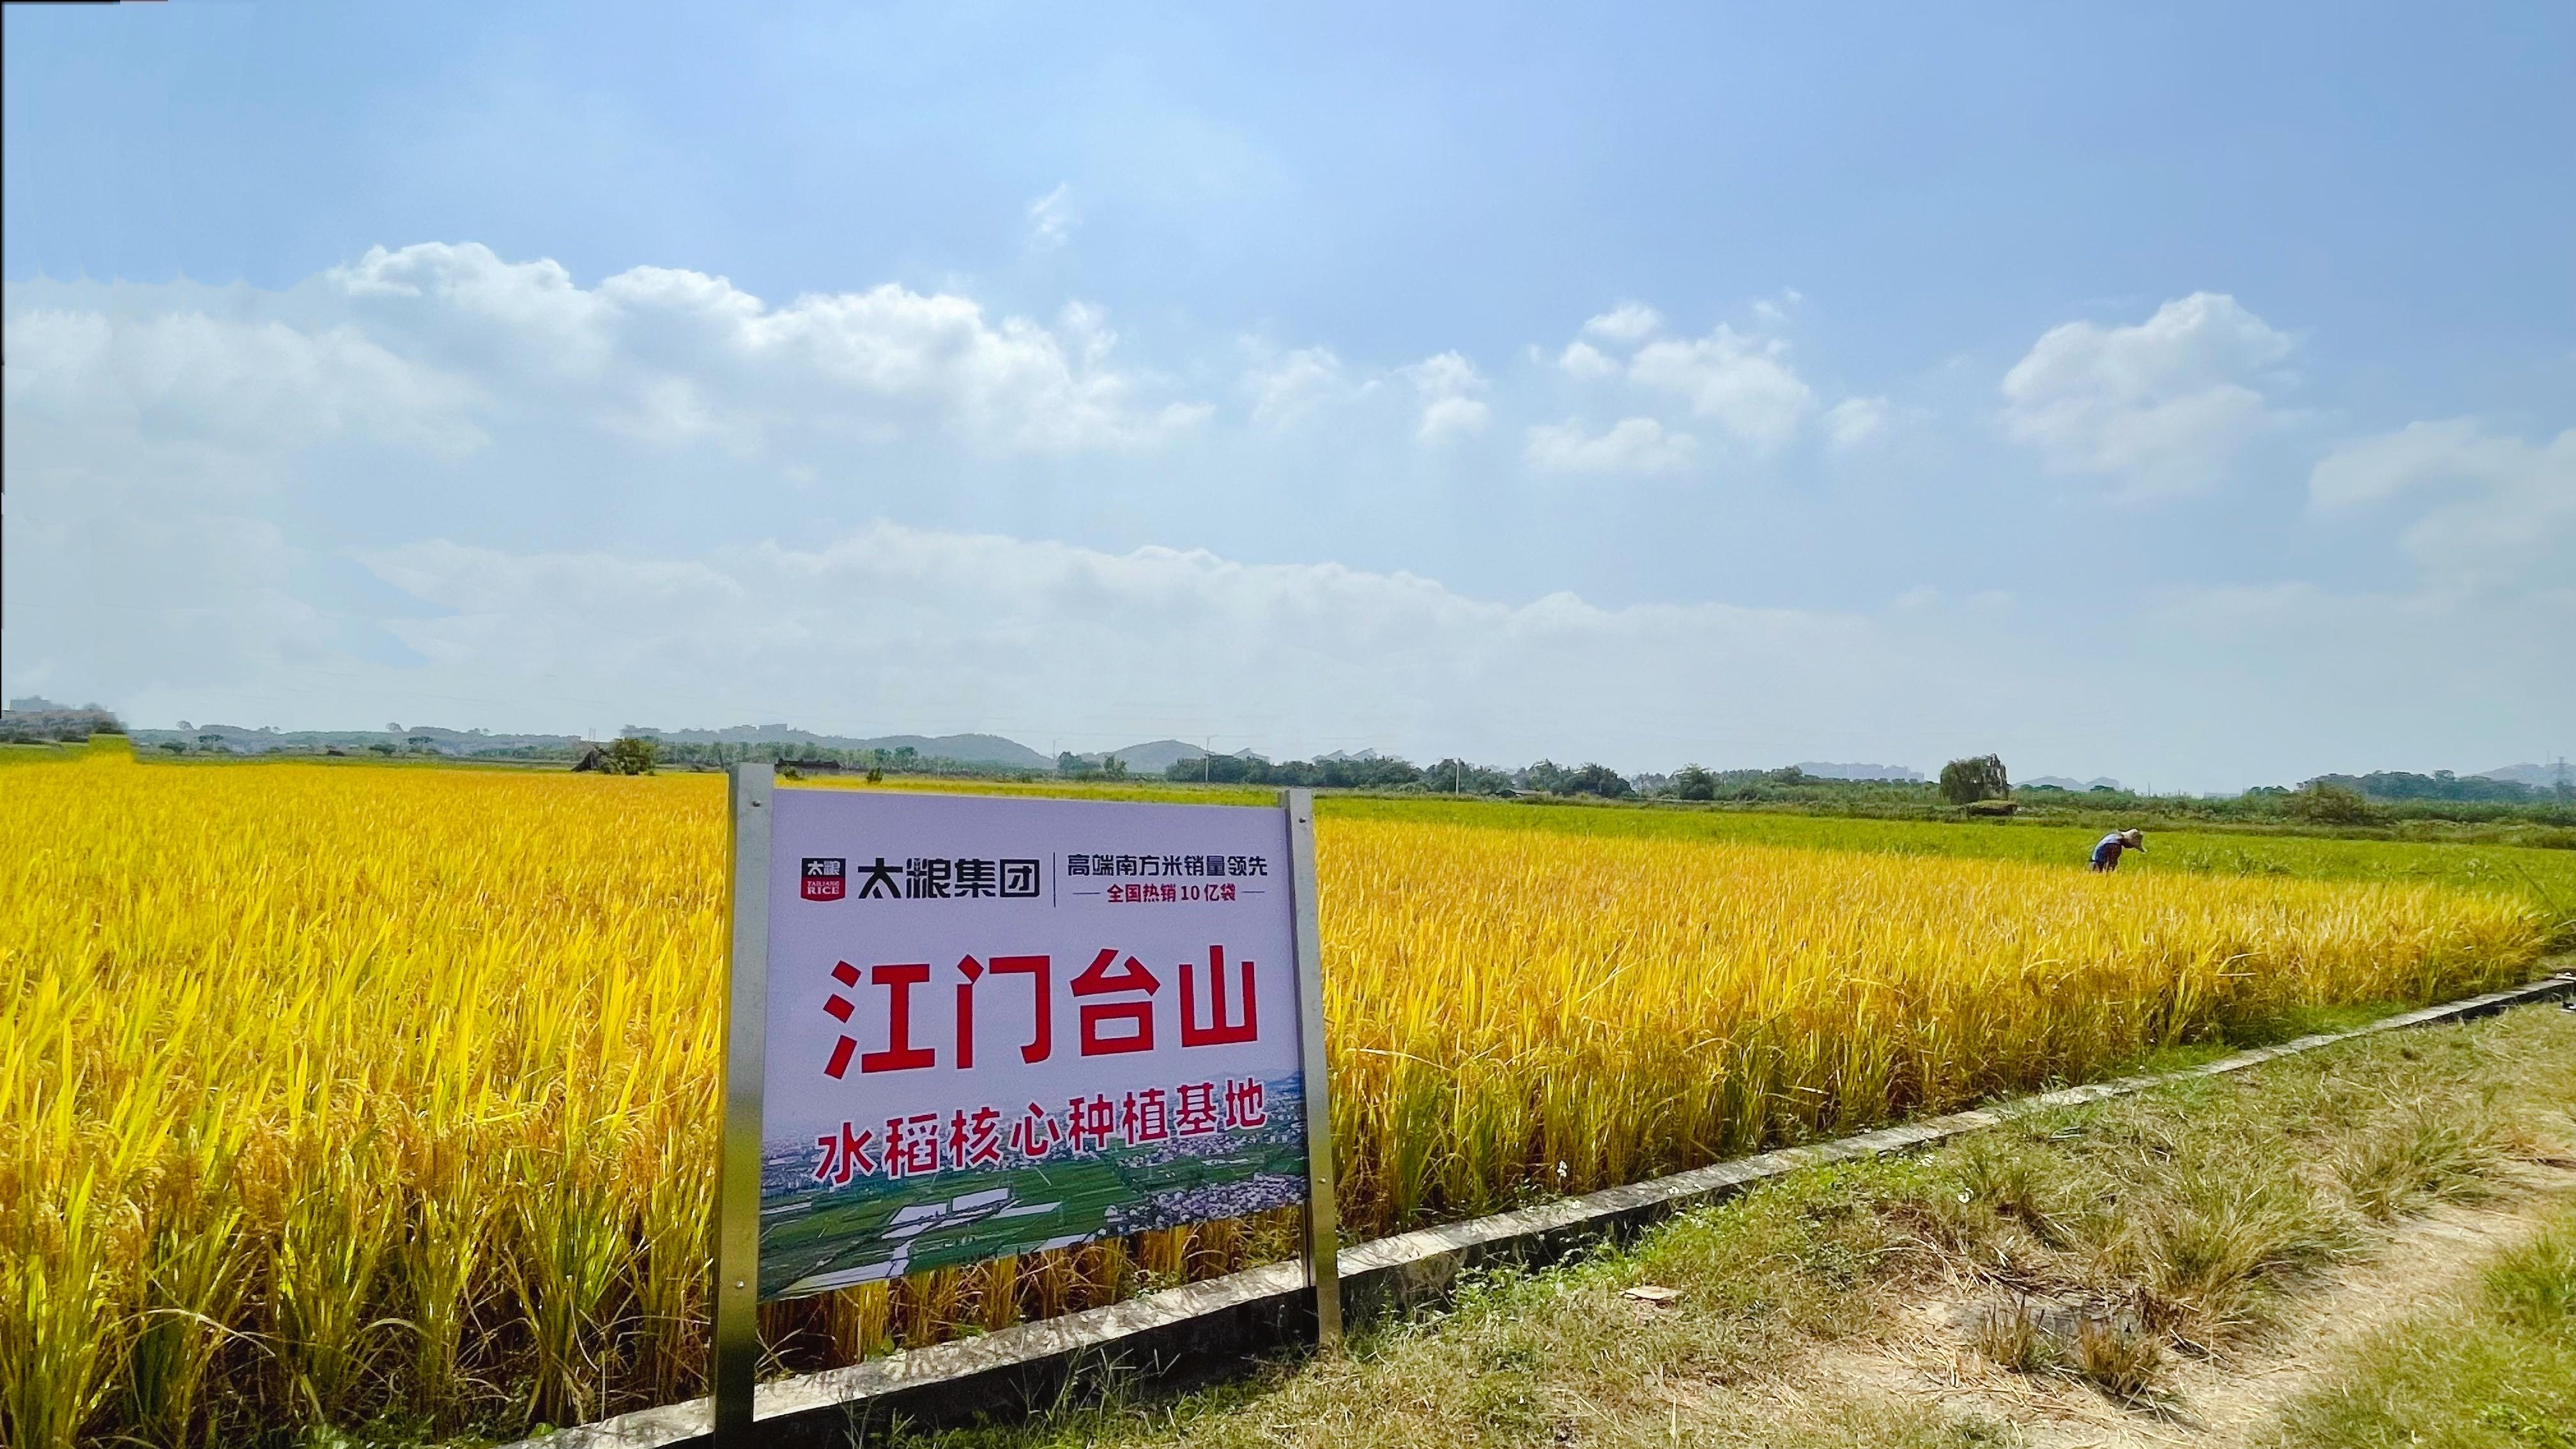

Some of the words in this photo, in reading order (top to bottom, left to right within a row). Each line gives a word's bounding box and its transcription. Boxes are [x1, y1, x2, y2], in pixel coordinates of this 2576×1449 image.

[808, 861, 840, 875] 太粮
[858, 857, 1040, 899] 太粮集团
[1068, 854, 1268, 877] 高端南方米销量领先
[823, 944, 1259, 1080] 江门台山
[815, 1077, 1267, 1184] 水稻核心种植基地
